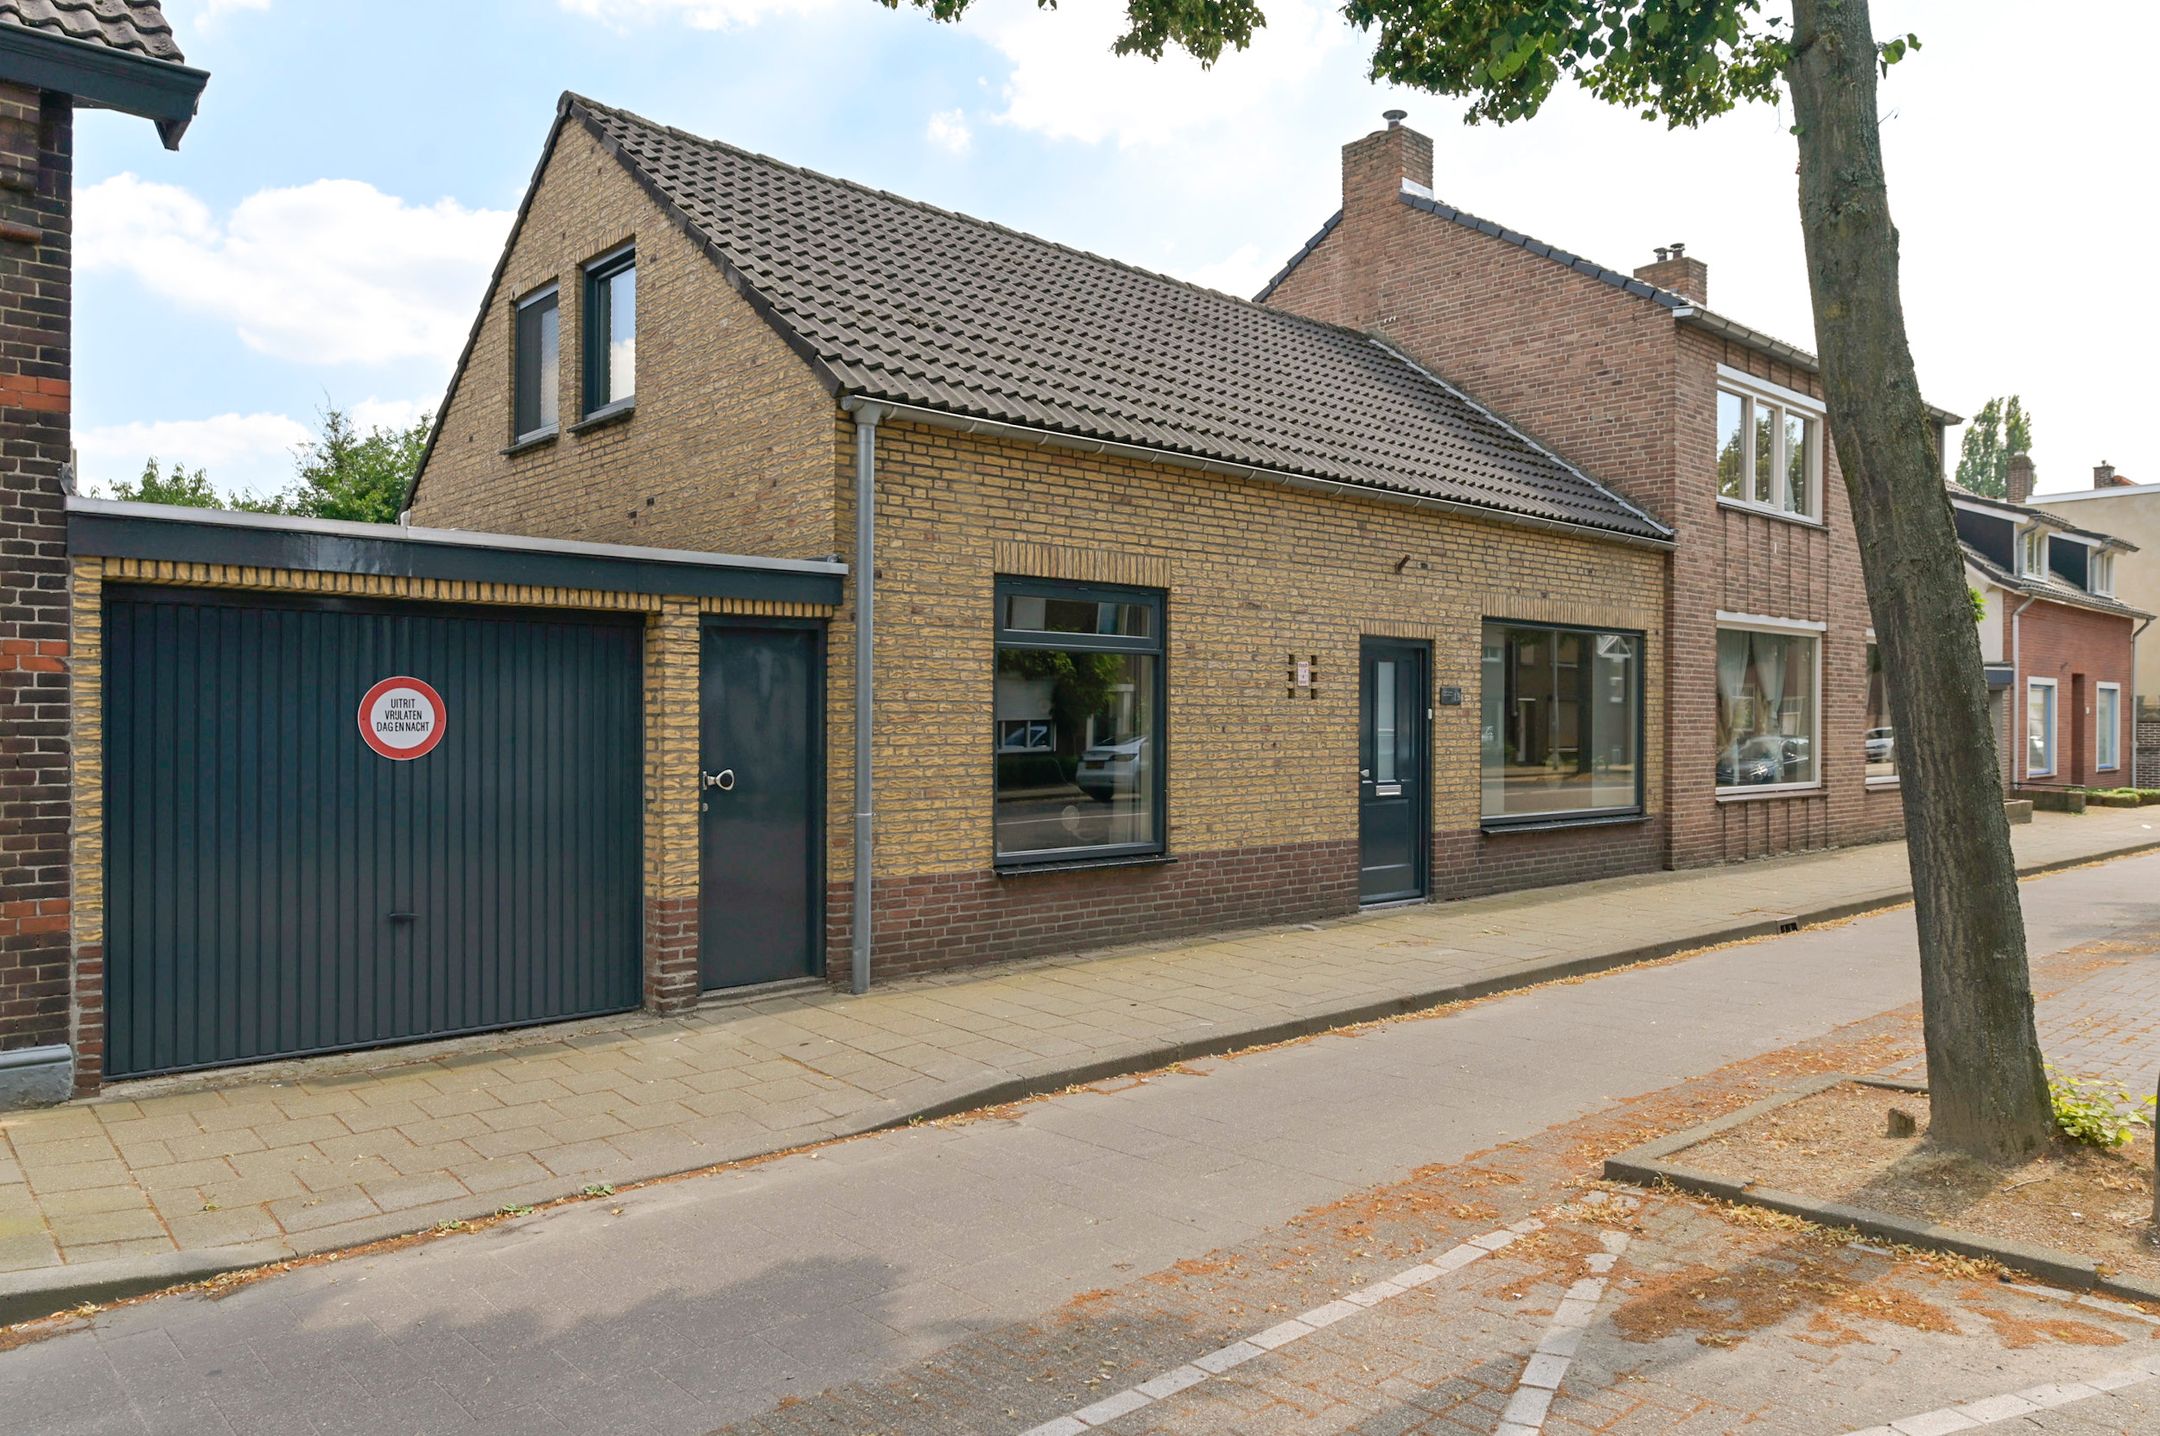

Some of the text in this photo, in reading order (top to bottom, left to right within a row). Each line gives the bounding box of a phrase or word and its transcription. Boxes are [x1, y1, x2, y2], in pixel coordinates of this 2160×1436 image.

[391, 698, 415, 708] UITRIT
[385, 710, 422, 720] VRIJLATEN
[376, 721, 429, 732] DAG EN NACHT
